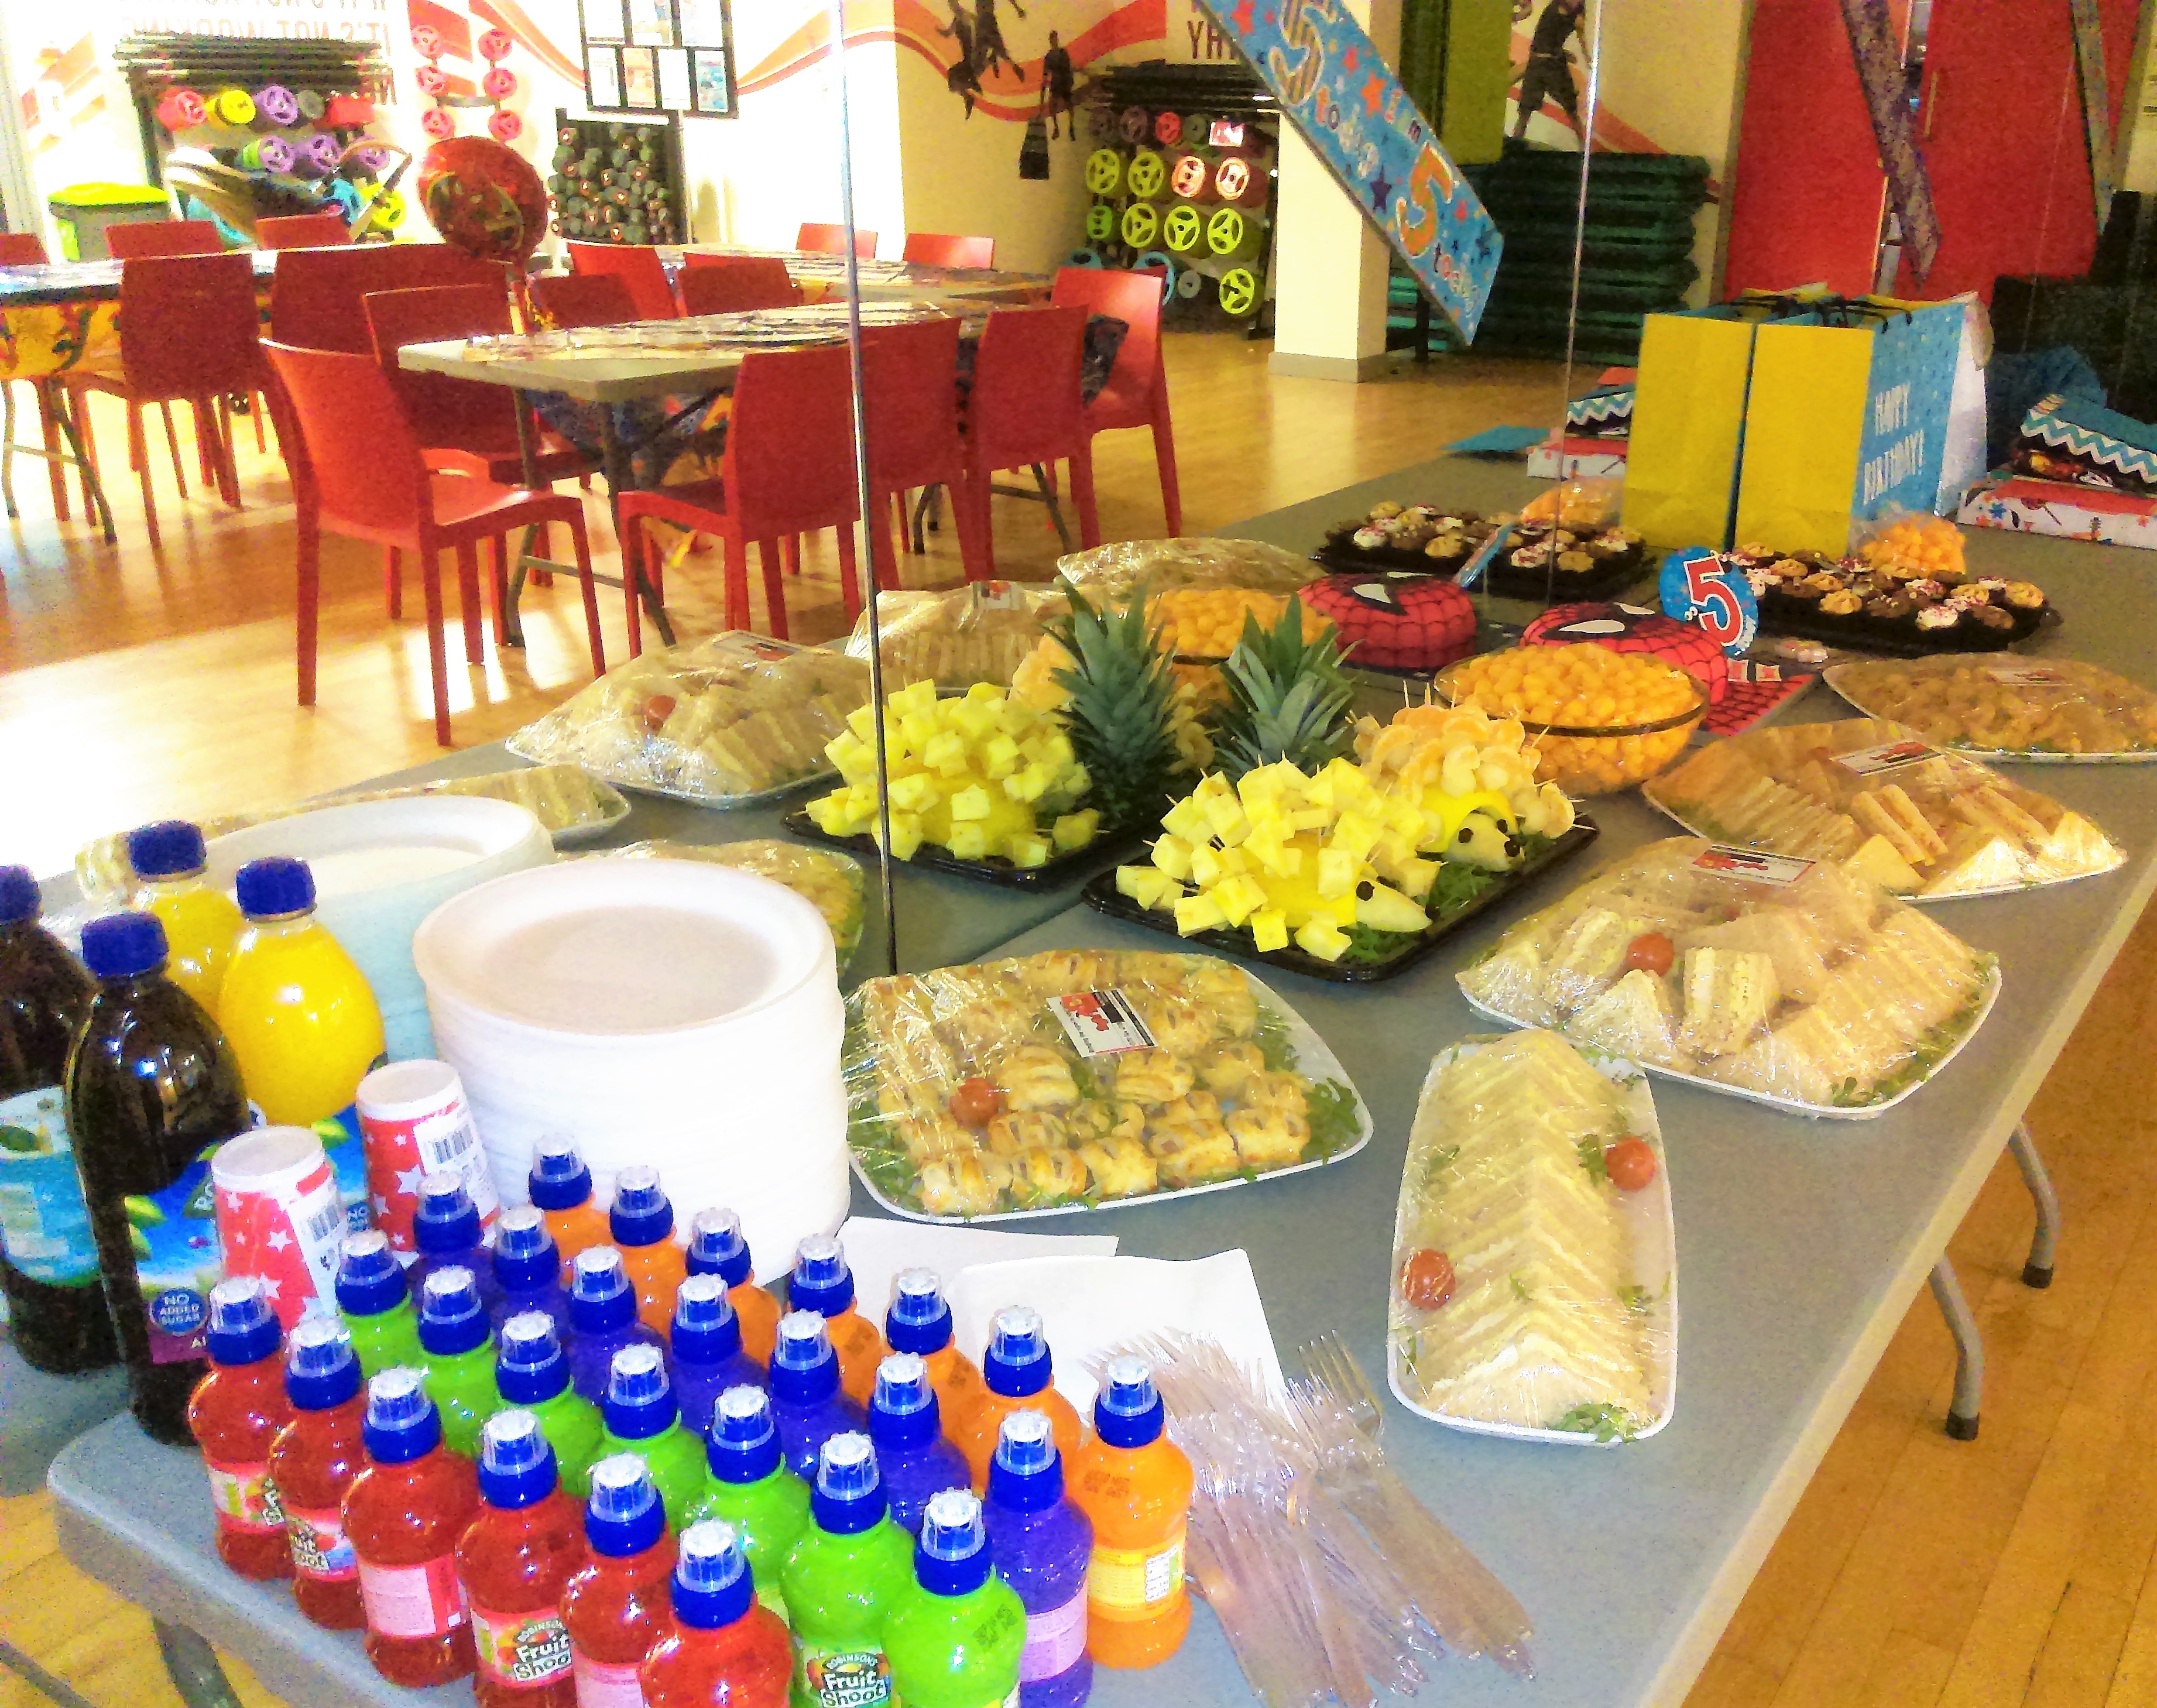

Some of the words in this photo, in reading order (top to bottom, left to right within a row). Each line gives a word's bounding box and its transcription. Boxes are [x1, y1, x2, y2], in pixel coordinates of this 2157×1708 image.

[1395, 139, 1453, 259] 5
[1683, 555, 1743, 647] 5
[164, 1293, 190, 1305] NO
[516, 1634, 570, 1663] Fruit
[515, 1652, 570, 1679] Shoo
[822, 1680, 884, 1706] Shoot
[824, 1670, 877, 1690] Fruit
